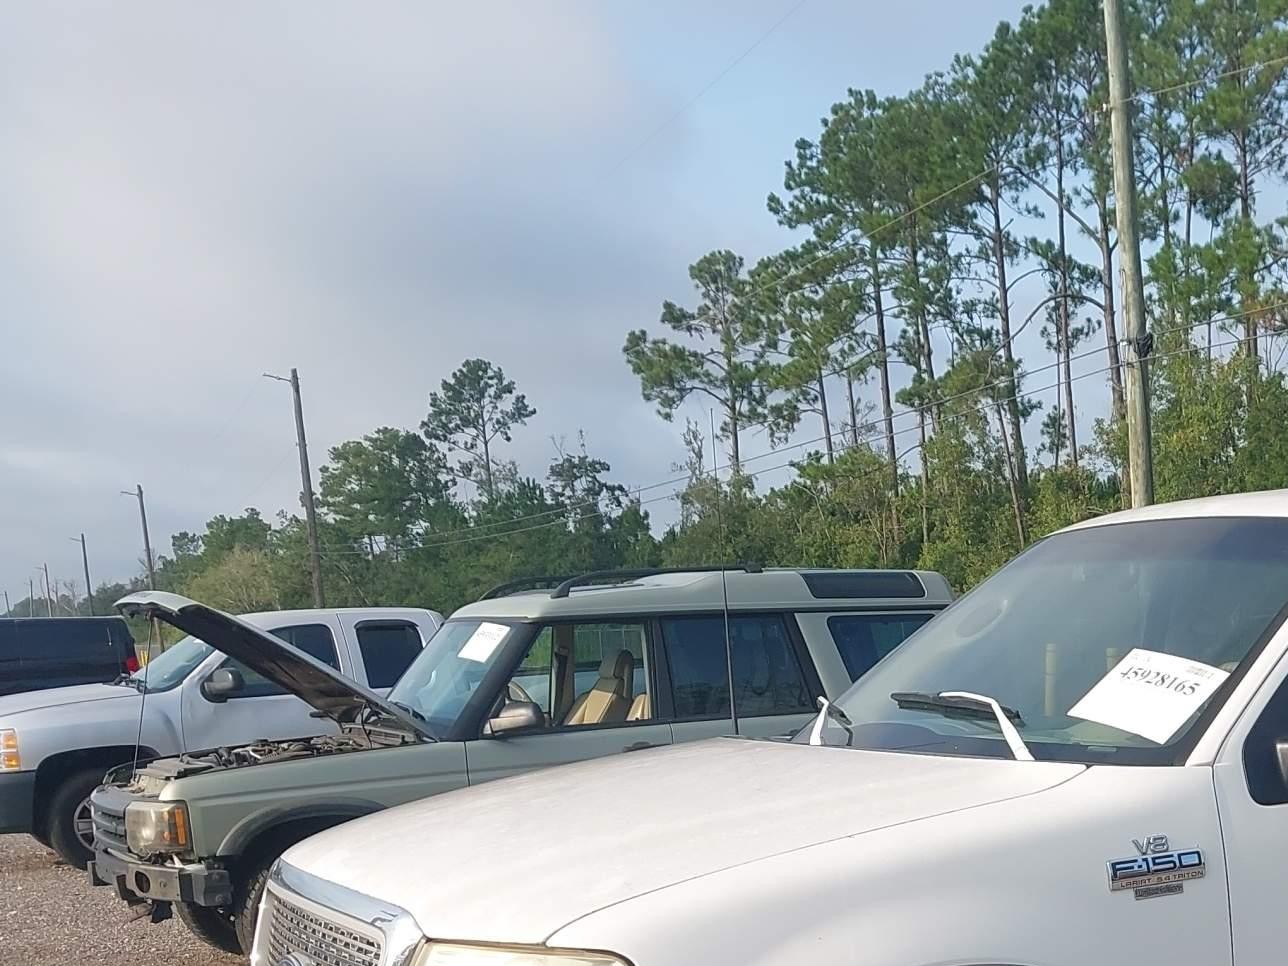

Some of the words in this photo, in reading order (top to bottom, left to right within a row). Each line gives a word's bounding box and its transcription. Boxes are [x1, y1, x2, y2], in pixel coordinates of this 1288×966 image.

[1120, 666, 1201, 696] 45928165
[1131, 833, 1169, 855] V8
[1110, 850, 1203, 880] F-150
[1173, 870, 1204, 880] TRITON
